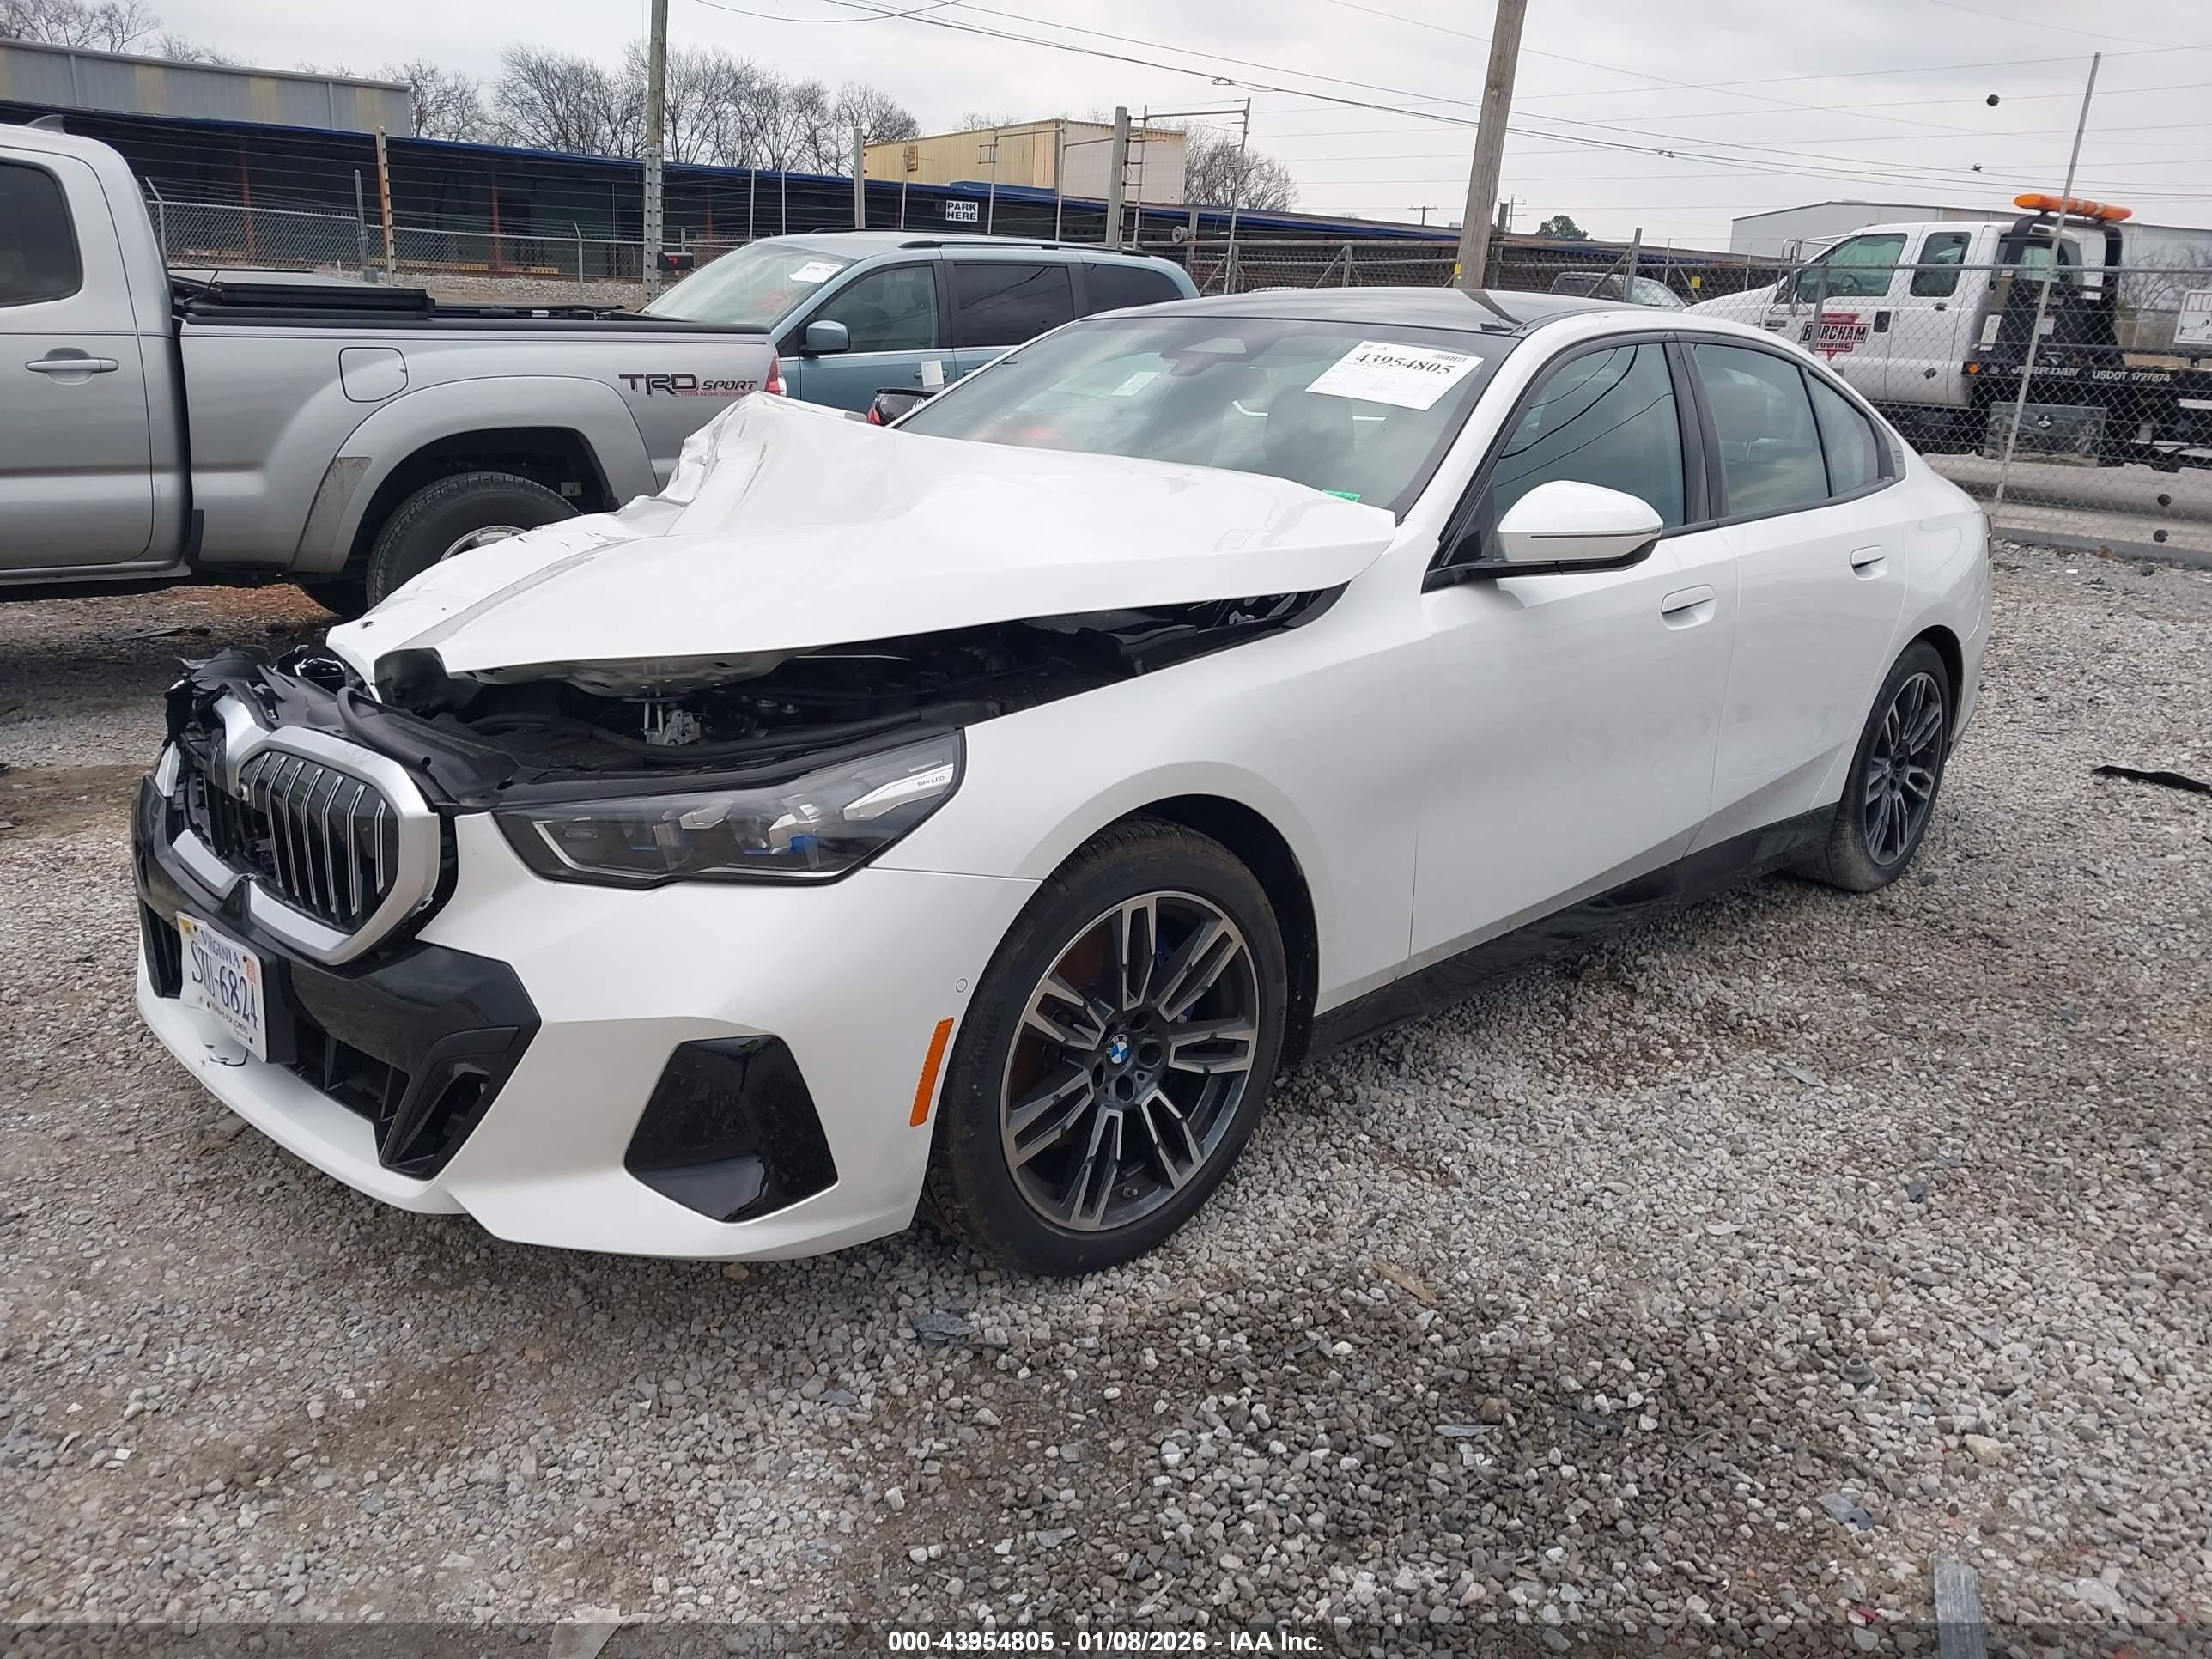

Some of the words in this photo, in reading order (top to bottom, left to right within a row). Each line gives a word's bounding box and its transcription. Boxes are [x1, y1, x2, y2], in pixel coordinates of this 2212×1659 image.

[947, 202, 977, 211] PARK
[947, 211, 976, 221] HERE
[1355, 352, 1456, 375] 43954805
[2092, 370, 2128, 380] USDOT
[2130, 372, 2171, 383] 1727874
[618, 374, 699, 397] TRD
[701, 380, 758, 391] SPORT
